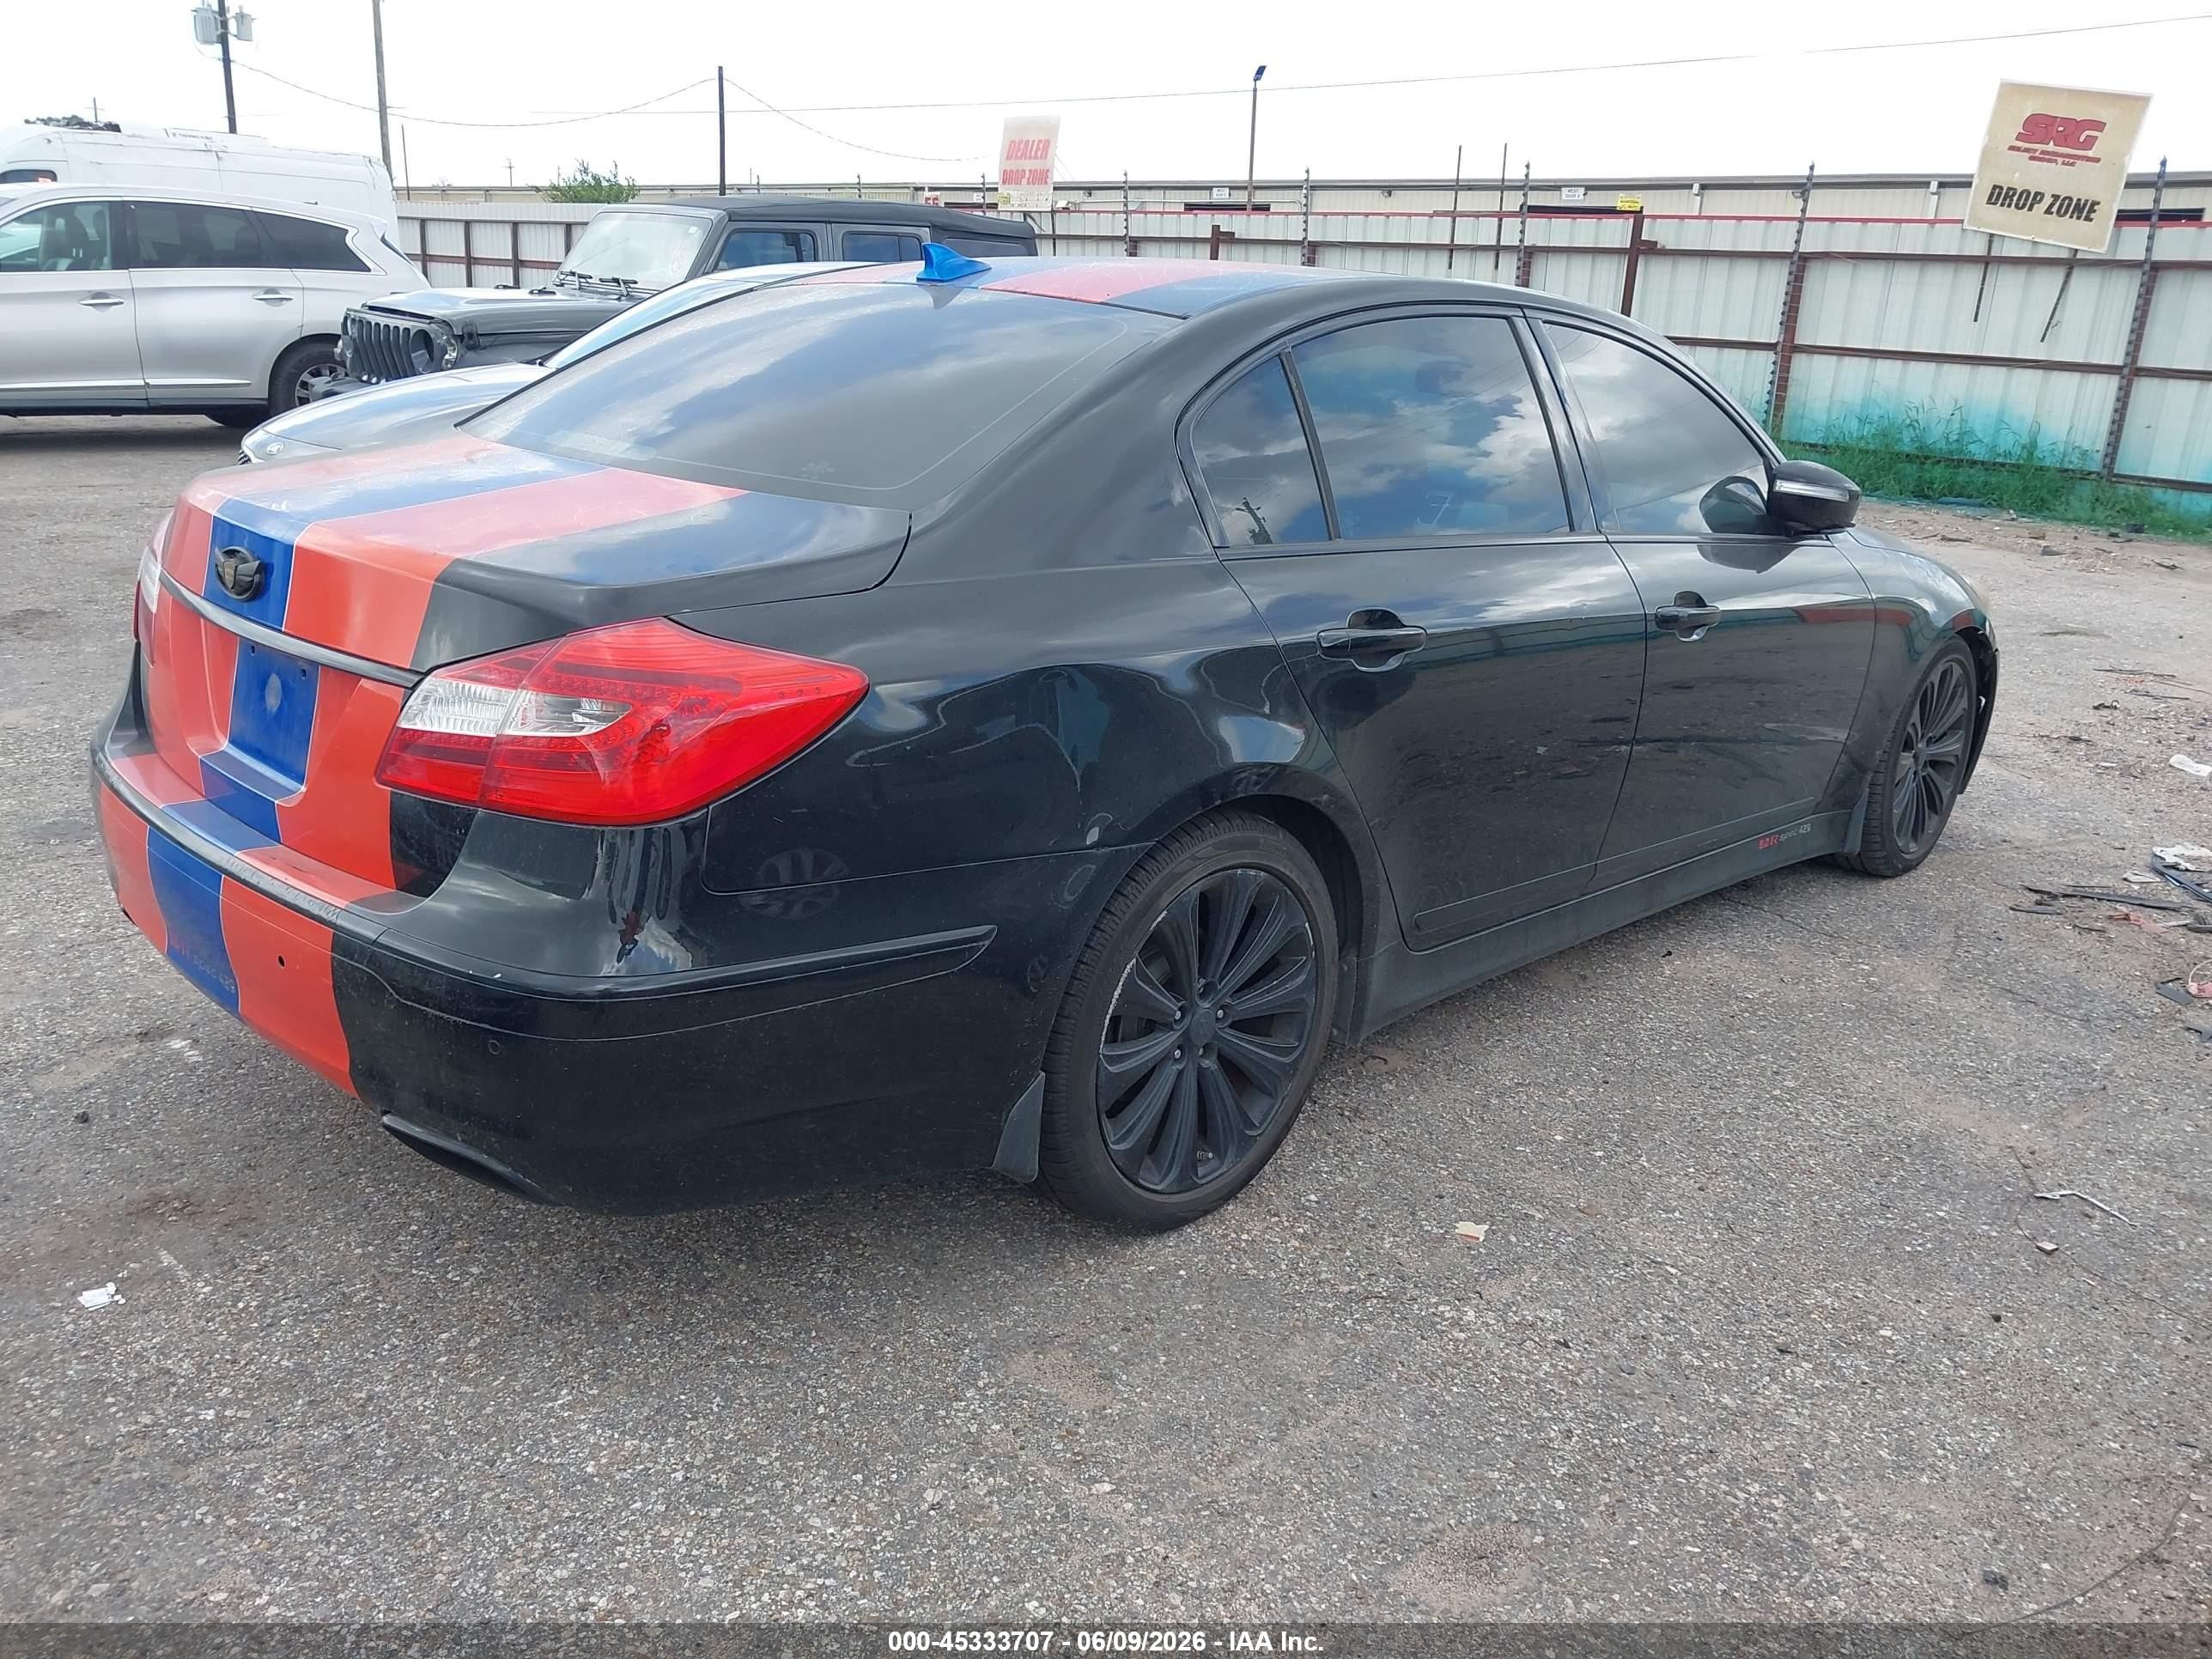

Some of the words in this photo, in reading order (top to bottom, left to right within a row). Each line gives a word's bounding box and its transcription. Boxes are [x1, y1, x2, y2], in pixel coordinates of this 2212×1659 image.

[2015, 112, 2106, 151] SRG
[1006, 139, 1051, 161] DEALER
[1002, 168, 1026, 185] DROP
[1026, 168, 1050, 185] ZONE
[1985, 185, 2045, 212] DROP
[2044, 194, 2101, 222] ZONE
